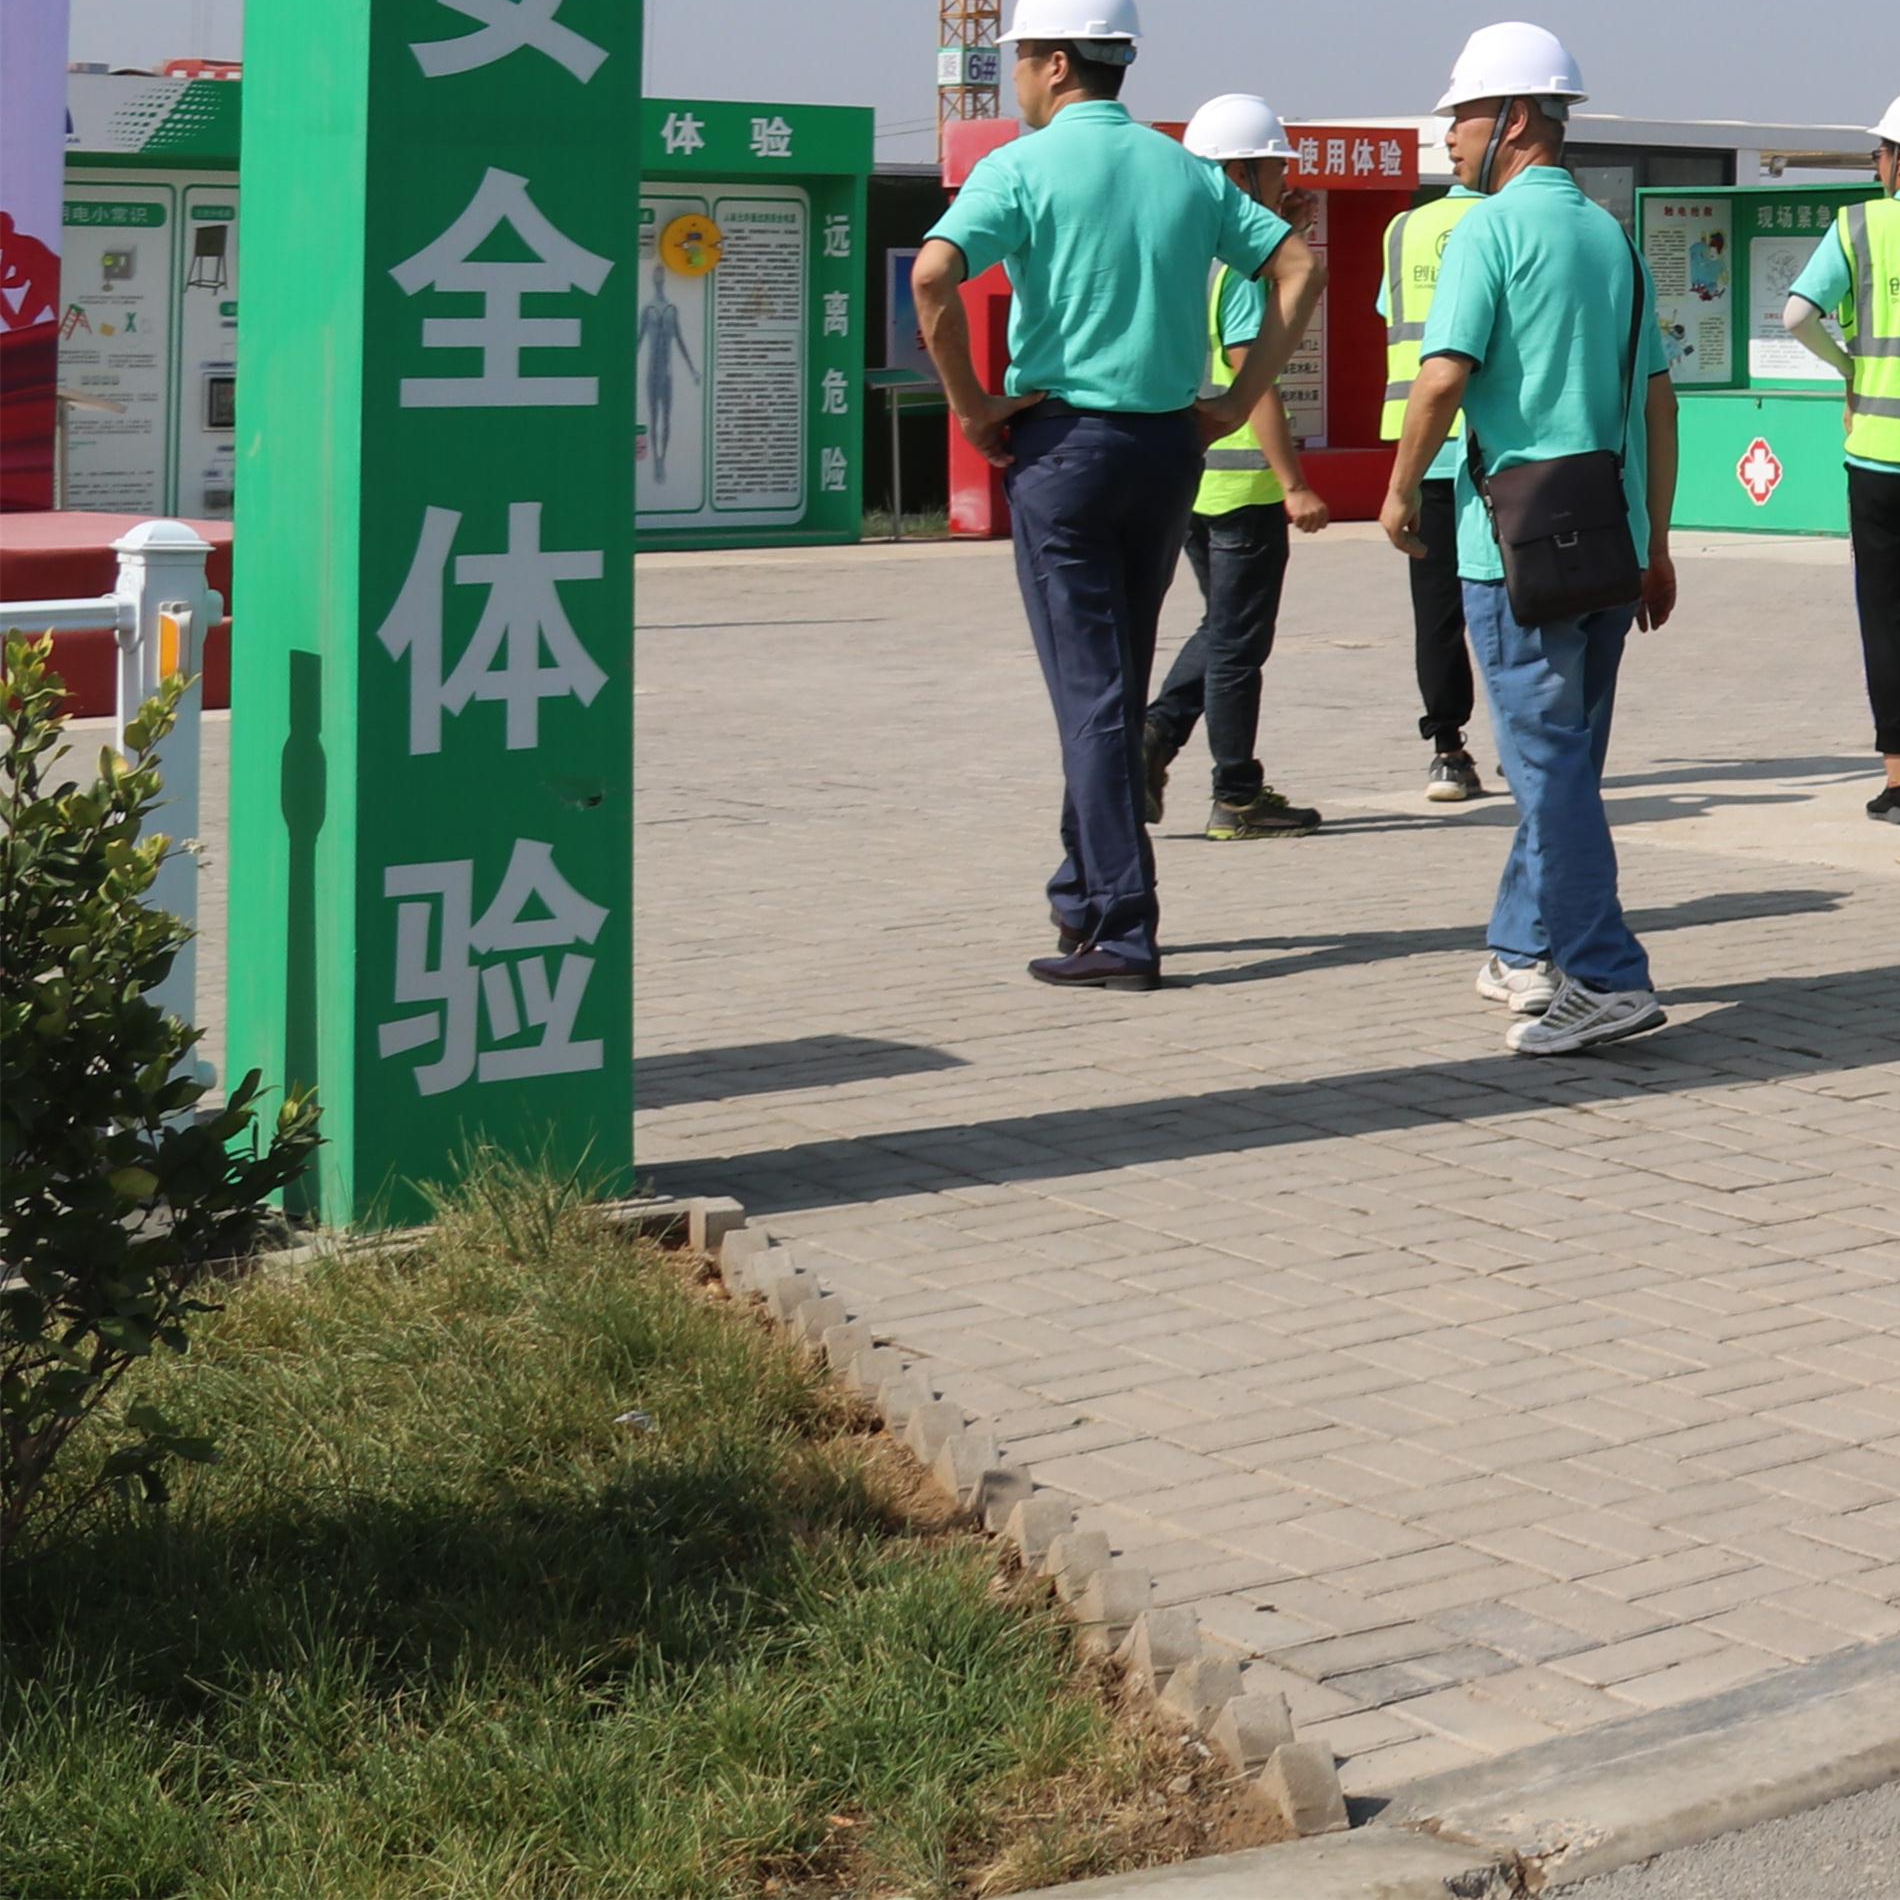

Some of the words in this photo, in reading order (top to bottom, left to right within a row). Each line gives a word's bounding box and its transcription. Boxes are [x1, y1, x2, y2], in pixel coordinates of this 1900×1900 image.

[968, 54, 997, 81] 6#
[662, 112, 794, 159] 体验
[1283, 137, 1403, 177] 使用体验
[820, 214, 850, 492] 远离危险
